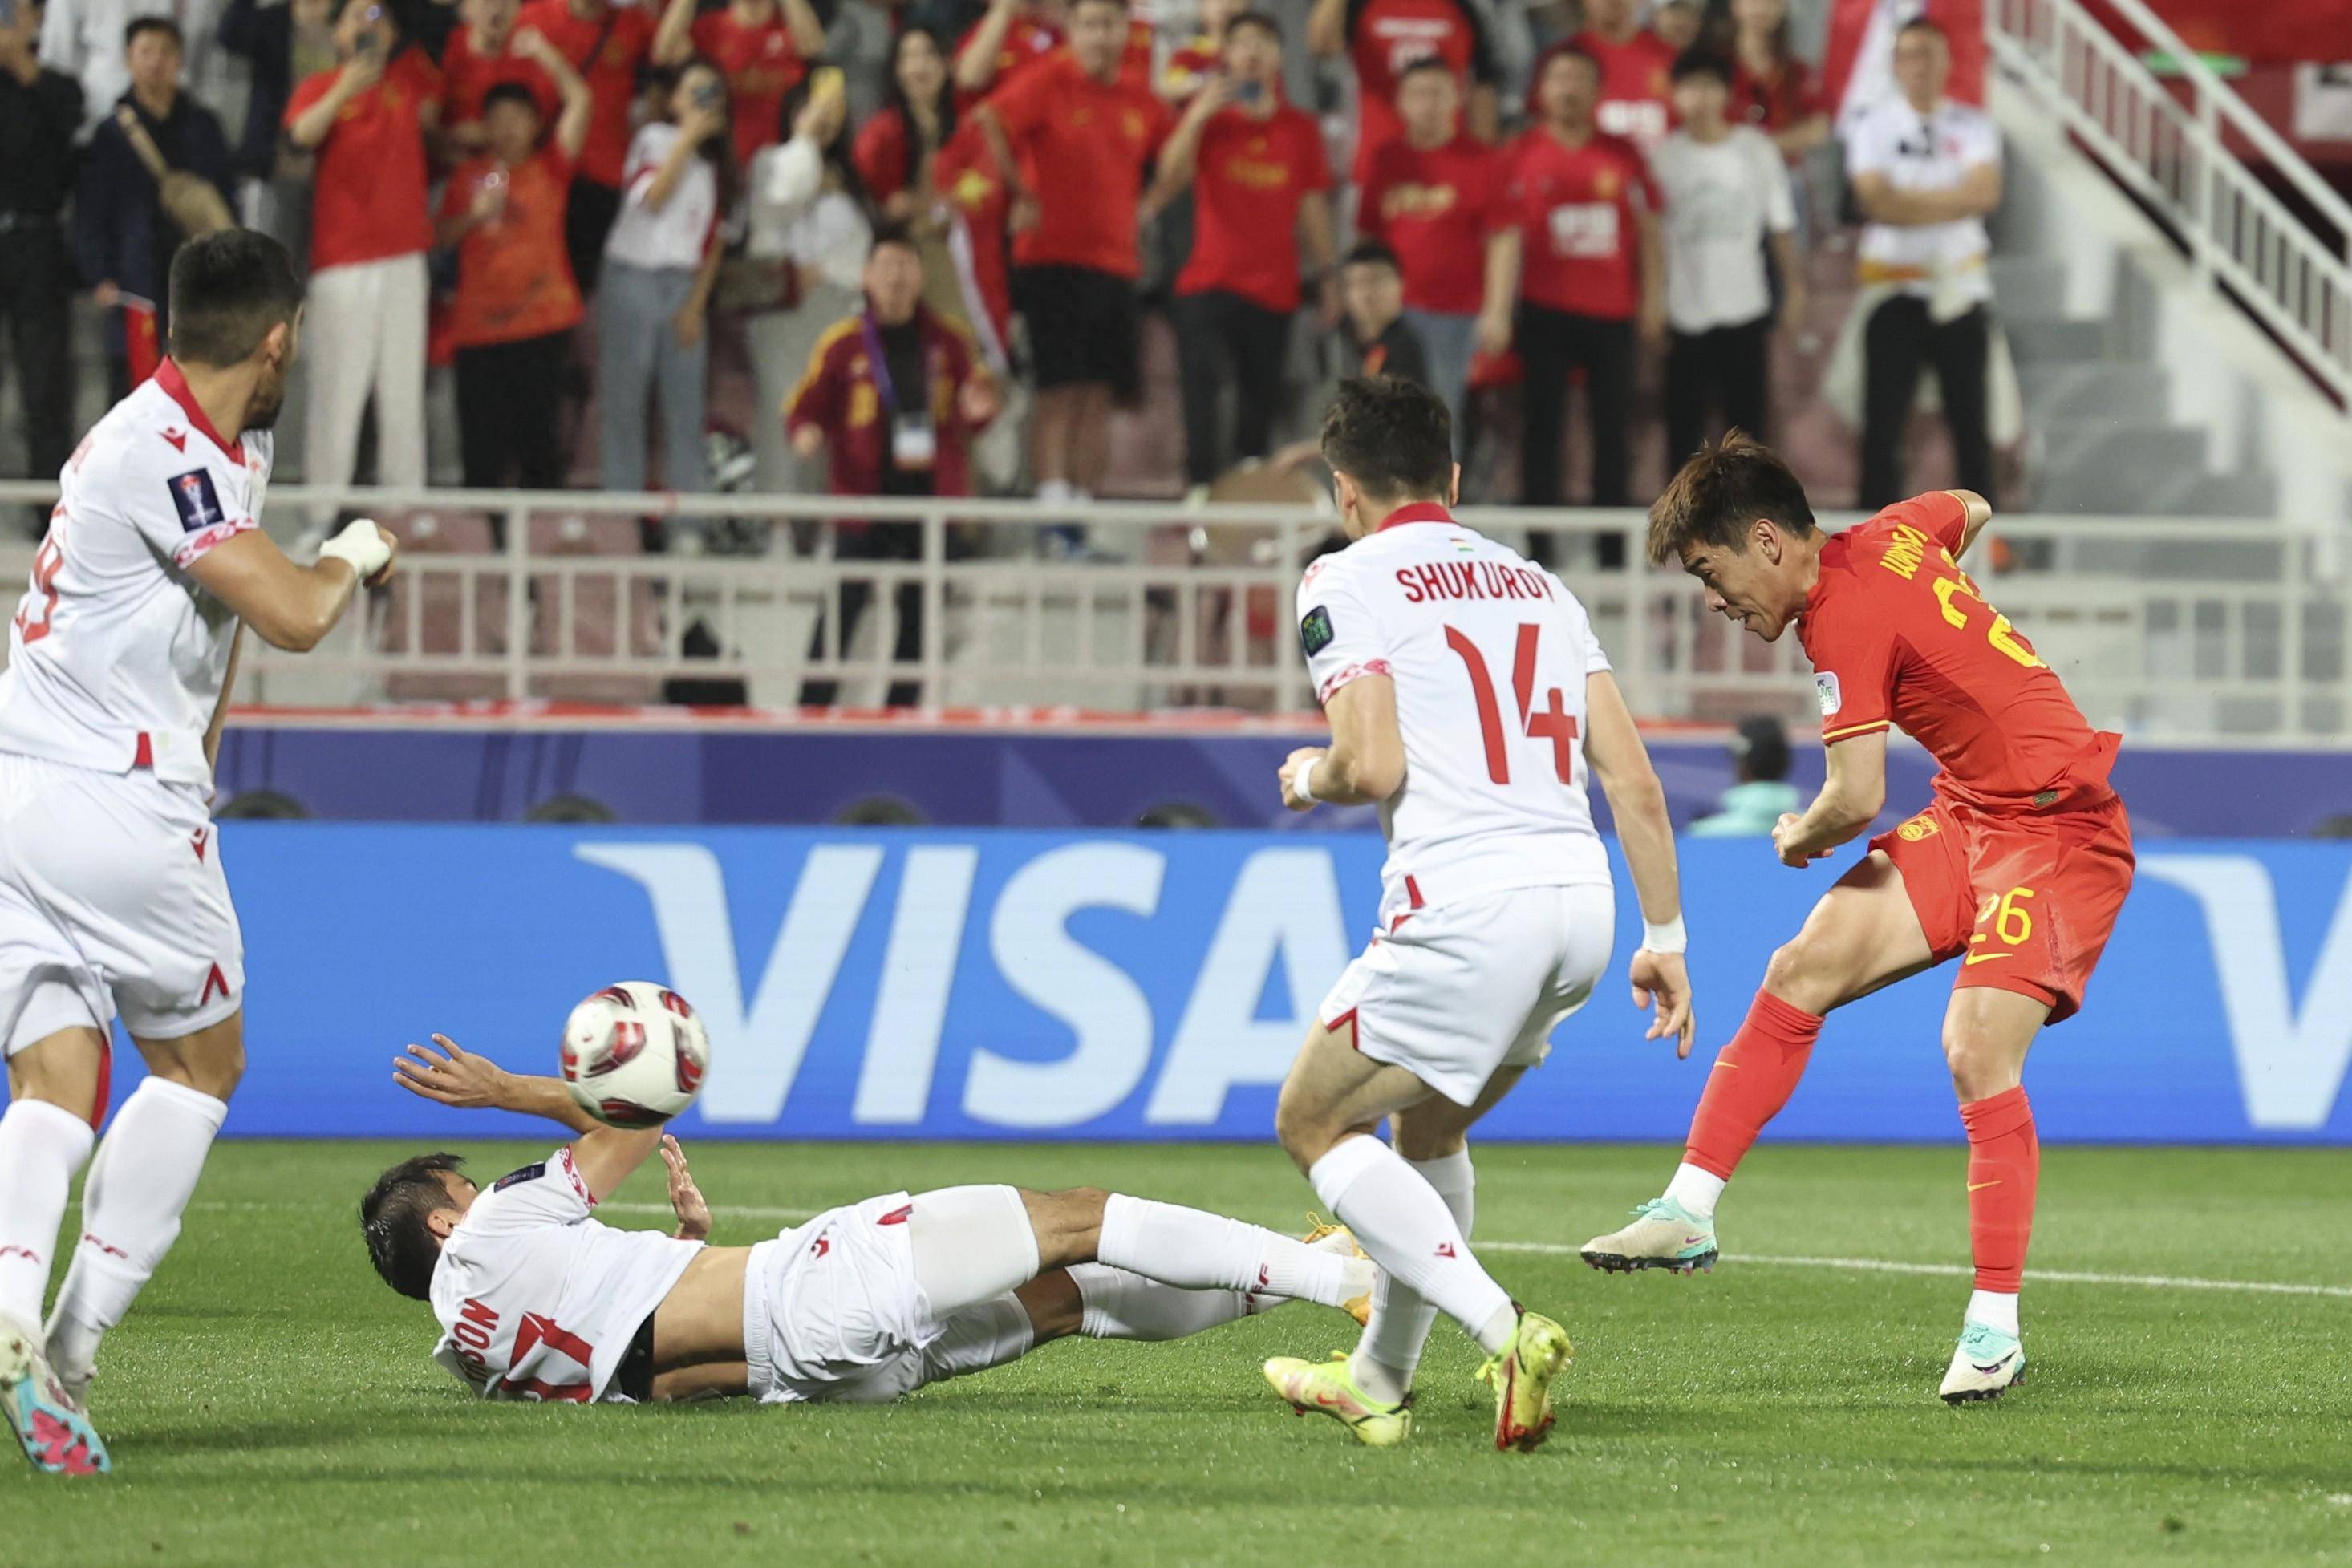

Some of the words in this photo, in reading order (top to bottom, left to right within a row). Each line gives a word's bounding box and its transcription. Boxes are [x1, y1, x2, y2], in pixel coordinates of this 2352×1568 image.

[1443, 623, 1579, 785] 14
[574, 841, 1351, 1130] VISA
[1969, 886, 2034, 946] 26
